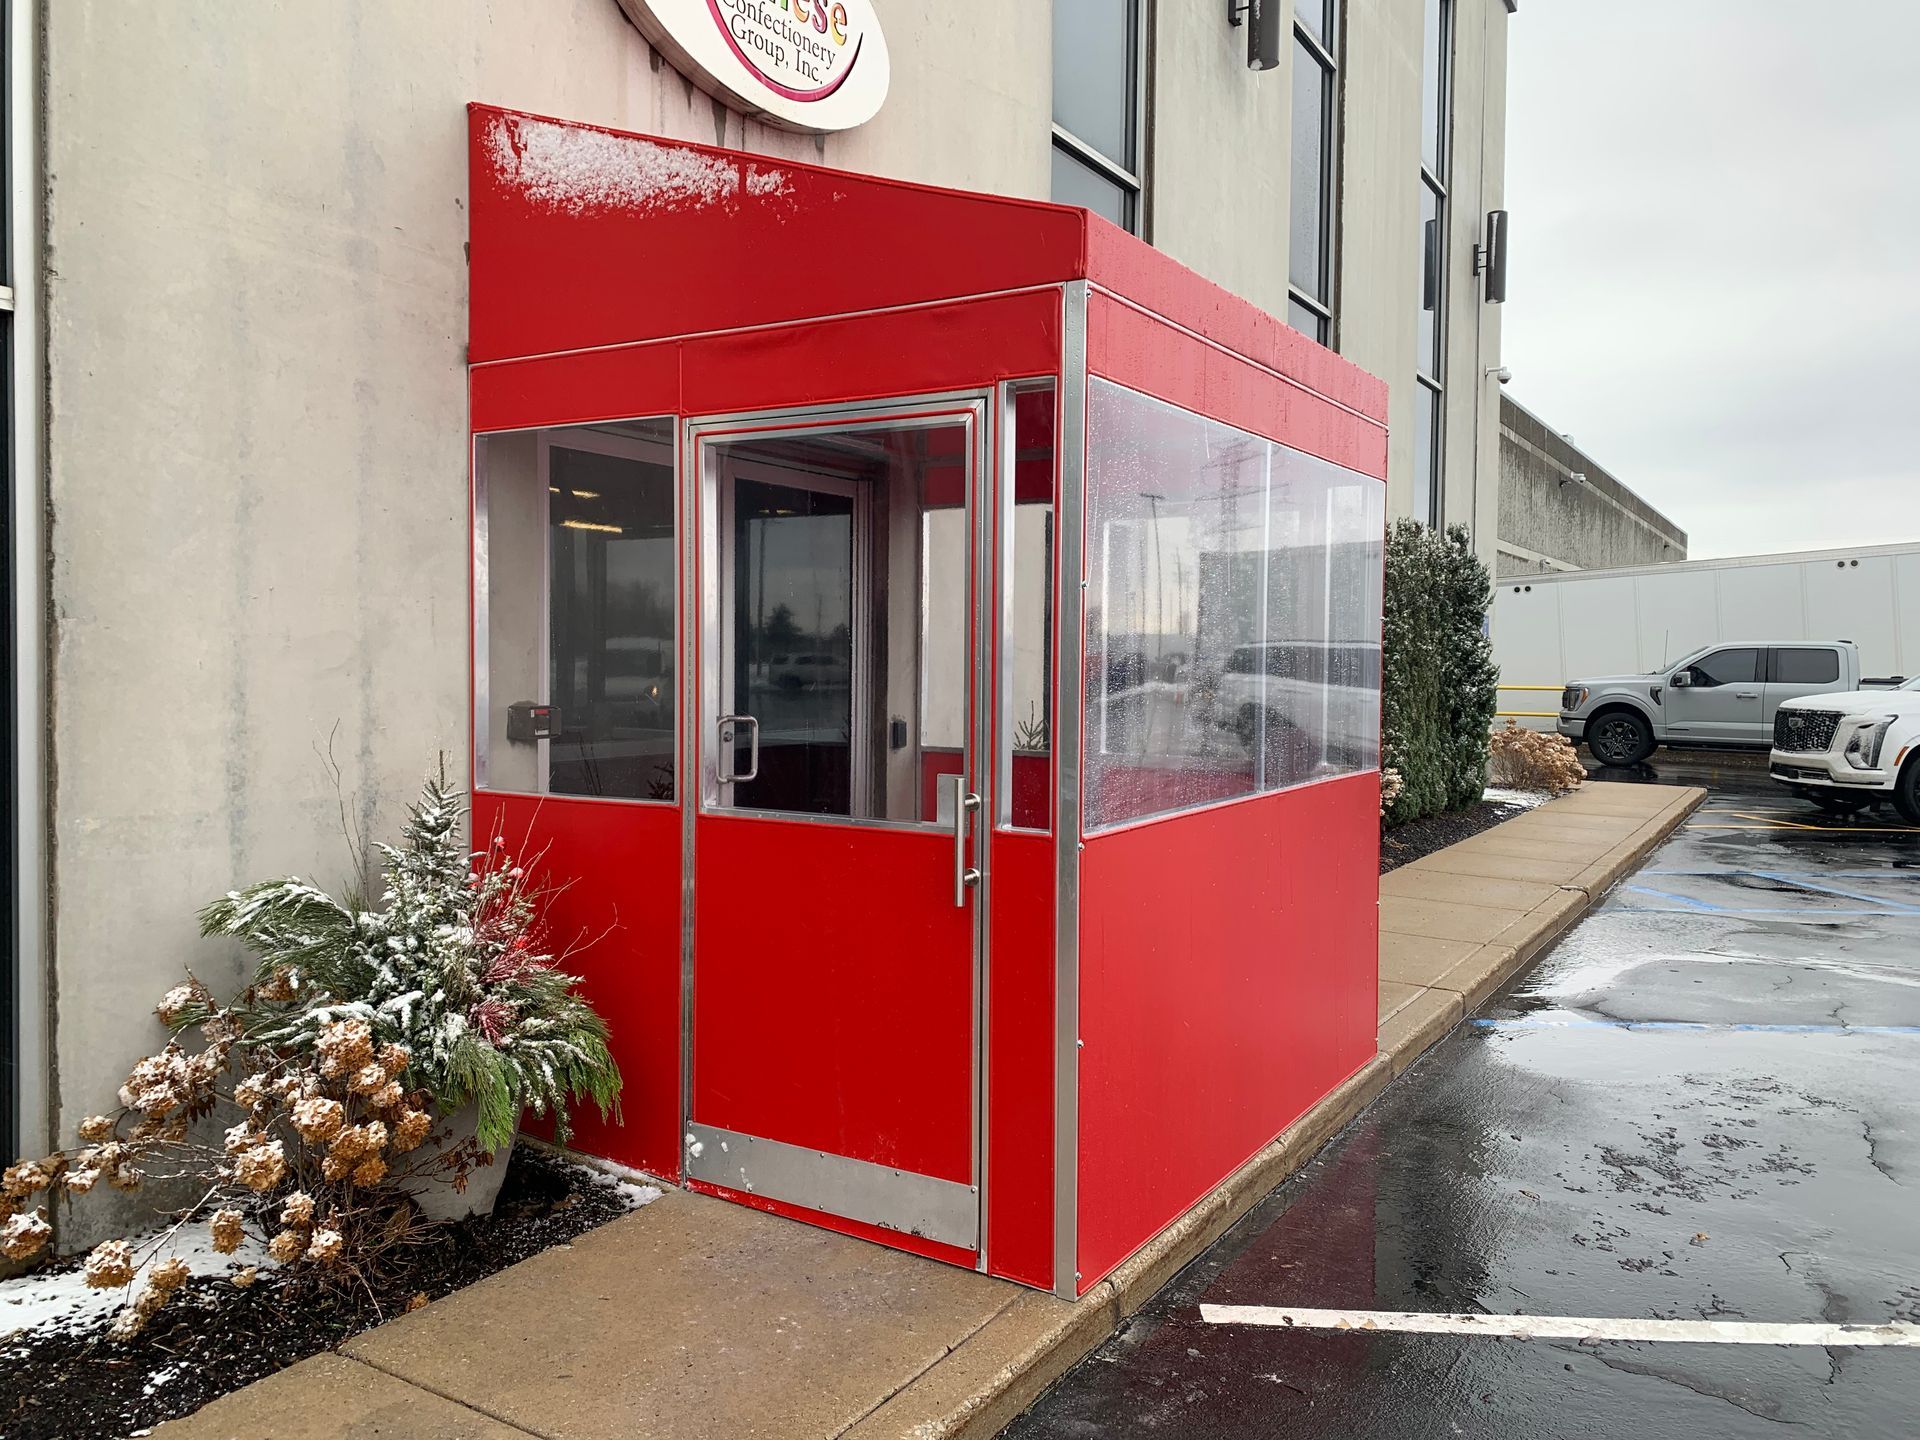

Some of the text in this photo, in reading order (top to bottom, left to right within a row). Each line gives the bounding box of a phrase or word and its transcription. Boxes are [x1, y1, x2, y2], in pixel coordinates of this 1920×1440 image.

[731, 14, 823, 84] Group, Inc.
[768, 0, 847, 46] ese
